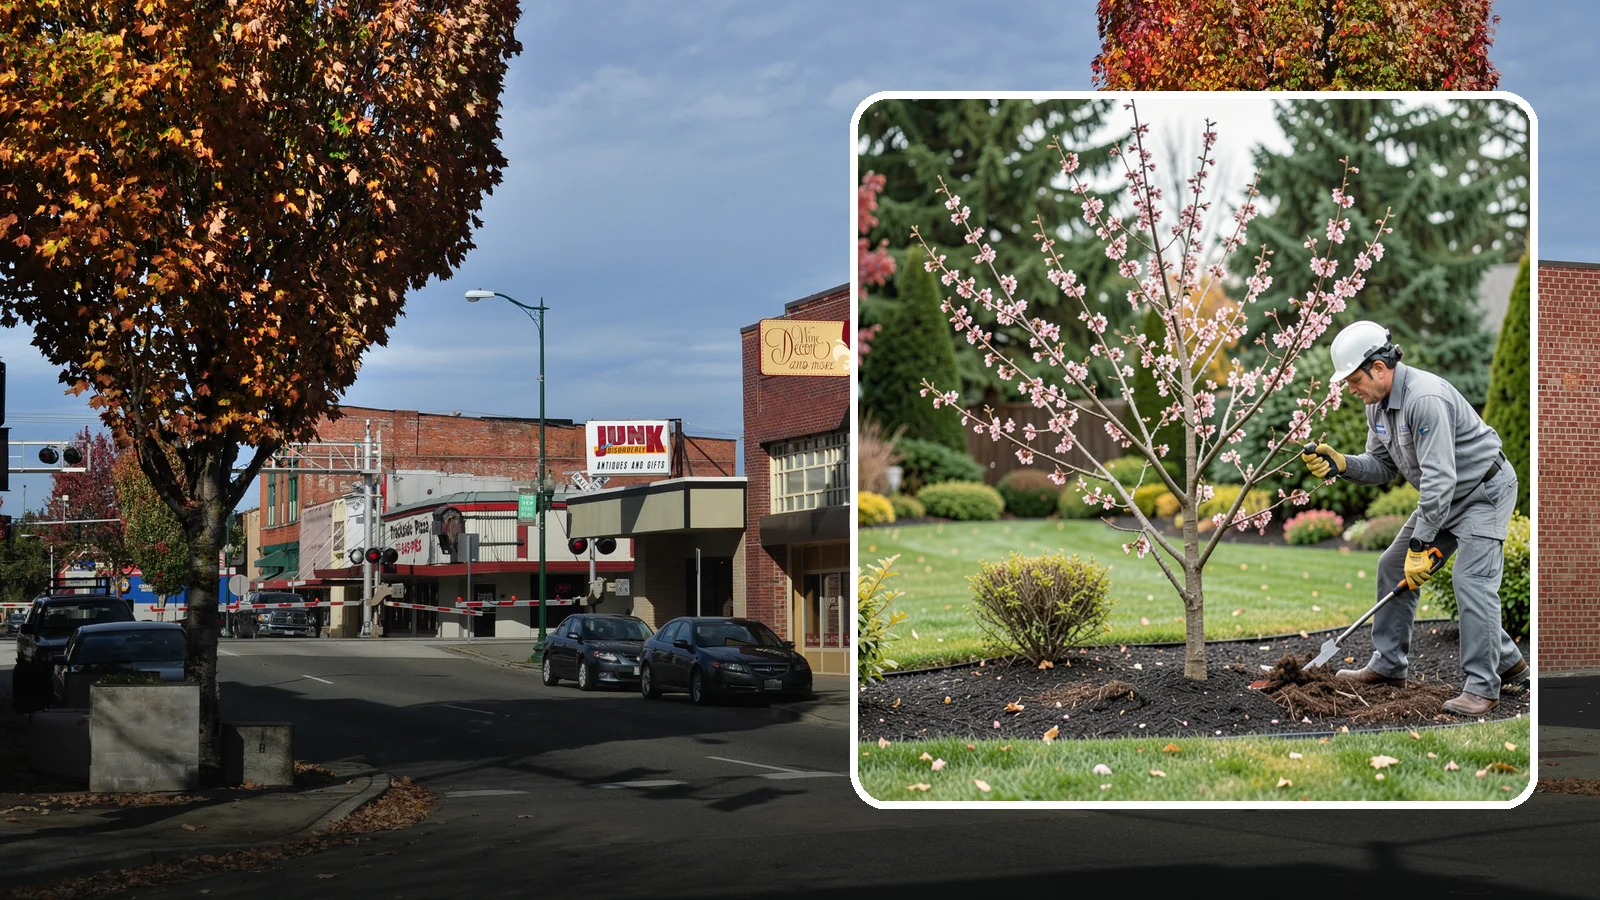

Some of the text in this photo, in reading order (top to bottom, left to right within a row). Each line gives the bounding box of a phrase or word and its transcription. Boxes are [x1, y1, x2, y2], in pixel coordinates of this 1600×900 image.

[765, 327, 830, 365] Decor
[595, 425, 665, 457] JUNK
[607, 446, 645, 454] DISORDERLY
[597, 461, 665, 470] ANTIQUES AND GIFTS
[415, 520, 429, 534] Pizza
